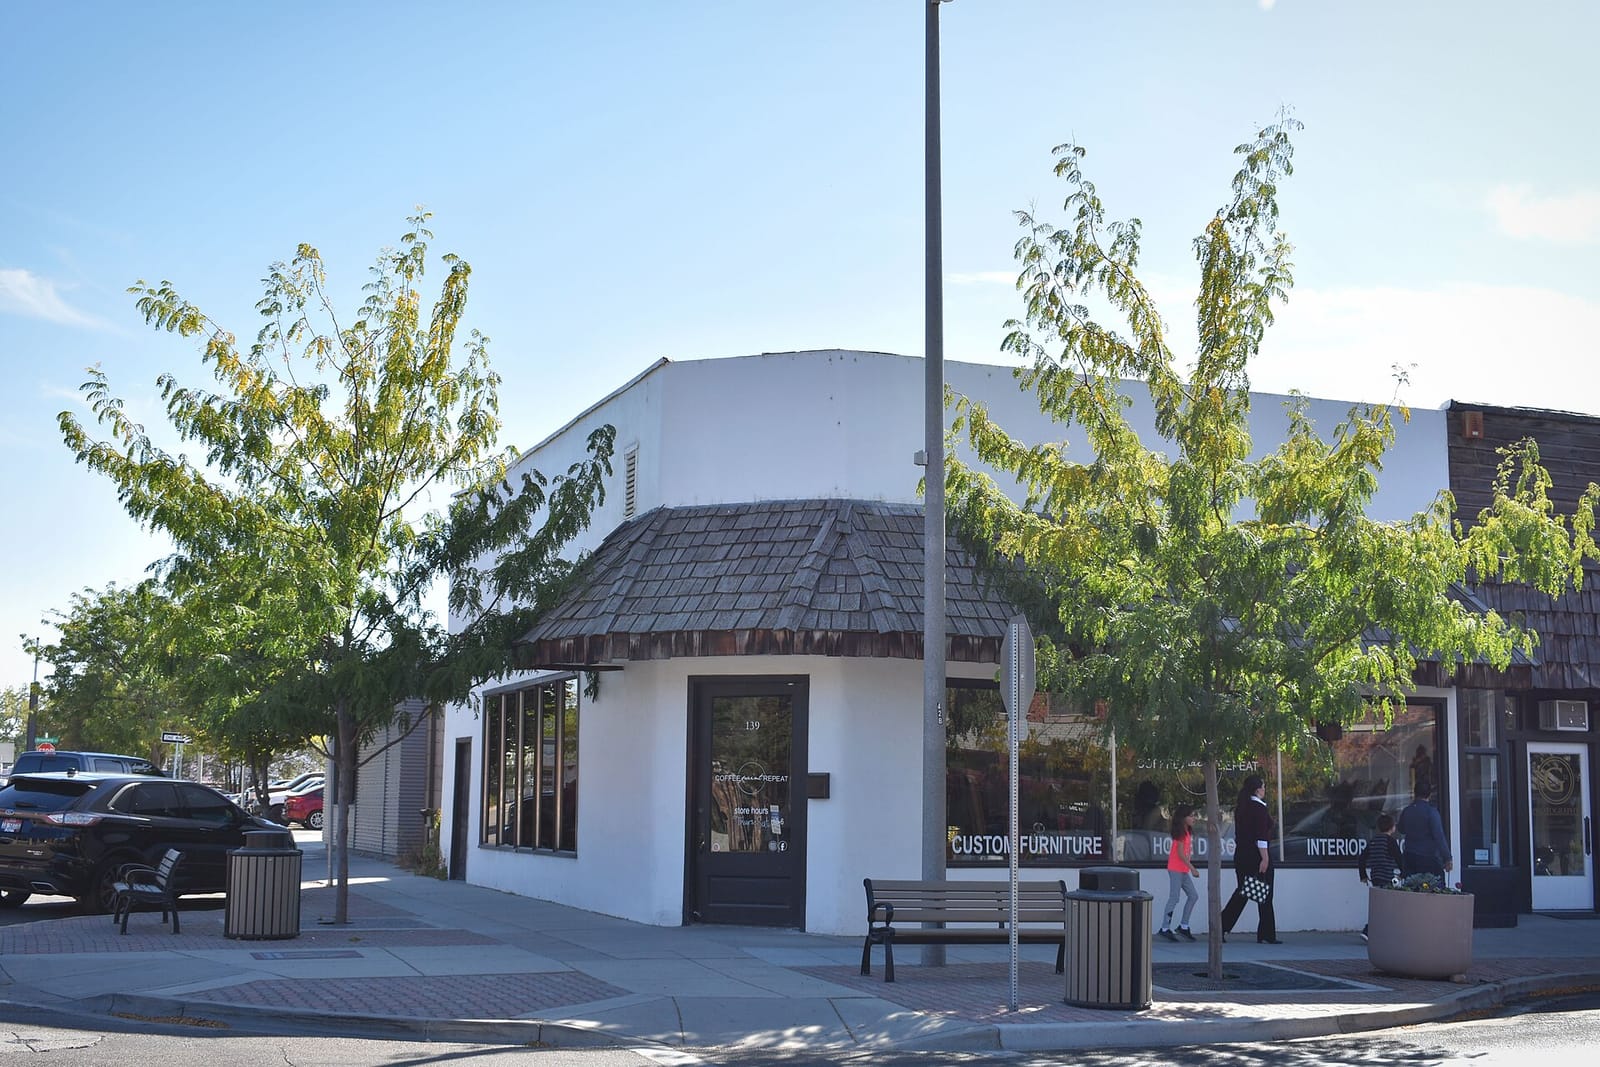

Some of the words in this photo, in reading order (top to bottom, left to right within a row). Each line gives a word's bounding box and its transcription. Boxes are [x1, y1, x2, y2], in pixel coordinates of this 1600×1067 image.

[745, 720, 760, 730] 139
[715, 774, 741, 782] COFFEE
[734, 807, 750, 815] store
[750, 806, 769, 815] hours
[1020, 836, 1102, 854] FURNITURE
